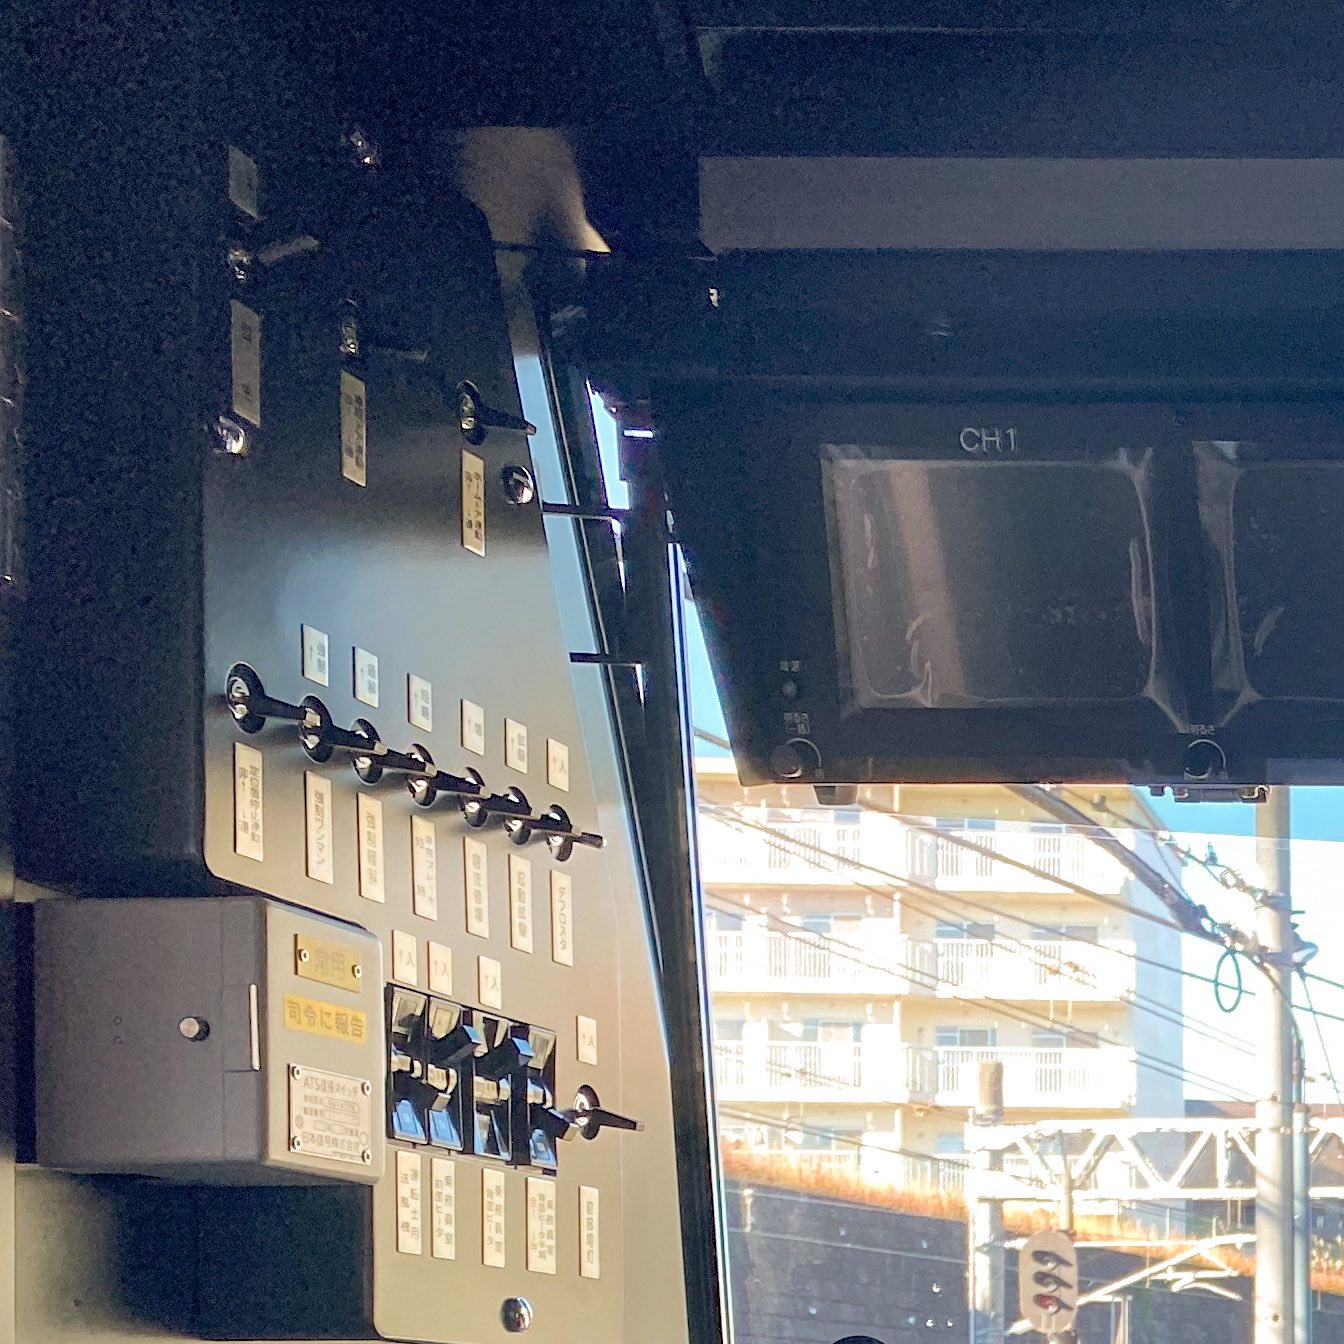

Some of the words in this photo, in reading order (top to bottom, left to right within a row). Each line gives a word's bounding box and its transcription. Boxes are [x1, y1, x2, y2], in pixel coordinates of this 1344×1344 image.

[960, 428, 1017, 452] CH1
[558, 885, 566, 951] デフロスタ
[287, 1000, 364, 1038] 司令に報告
